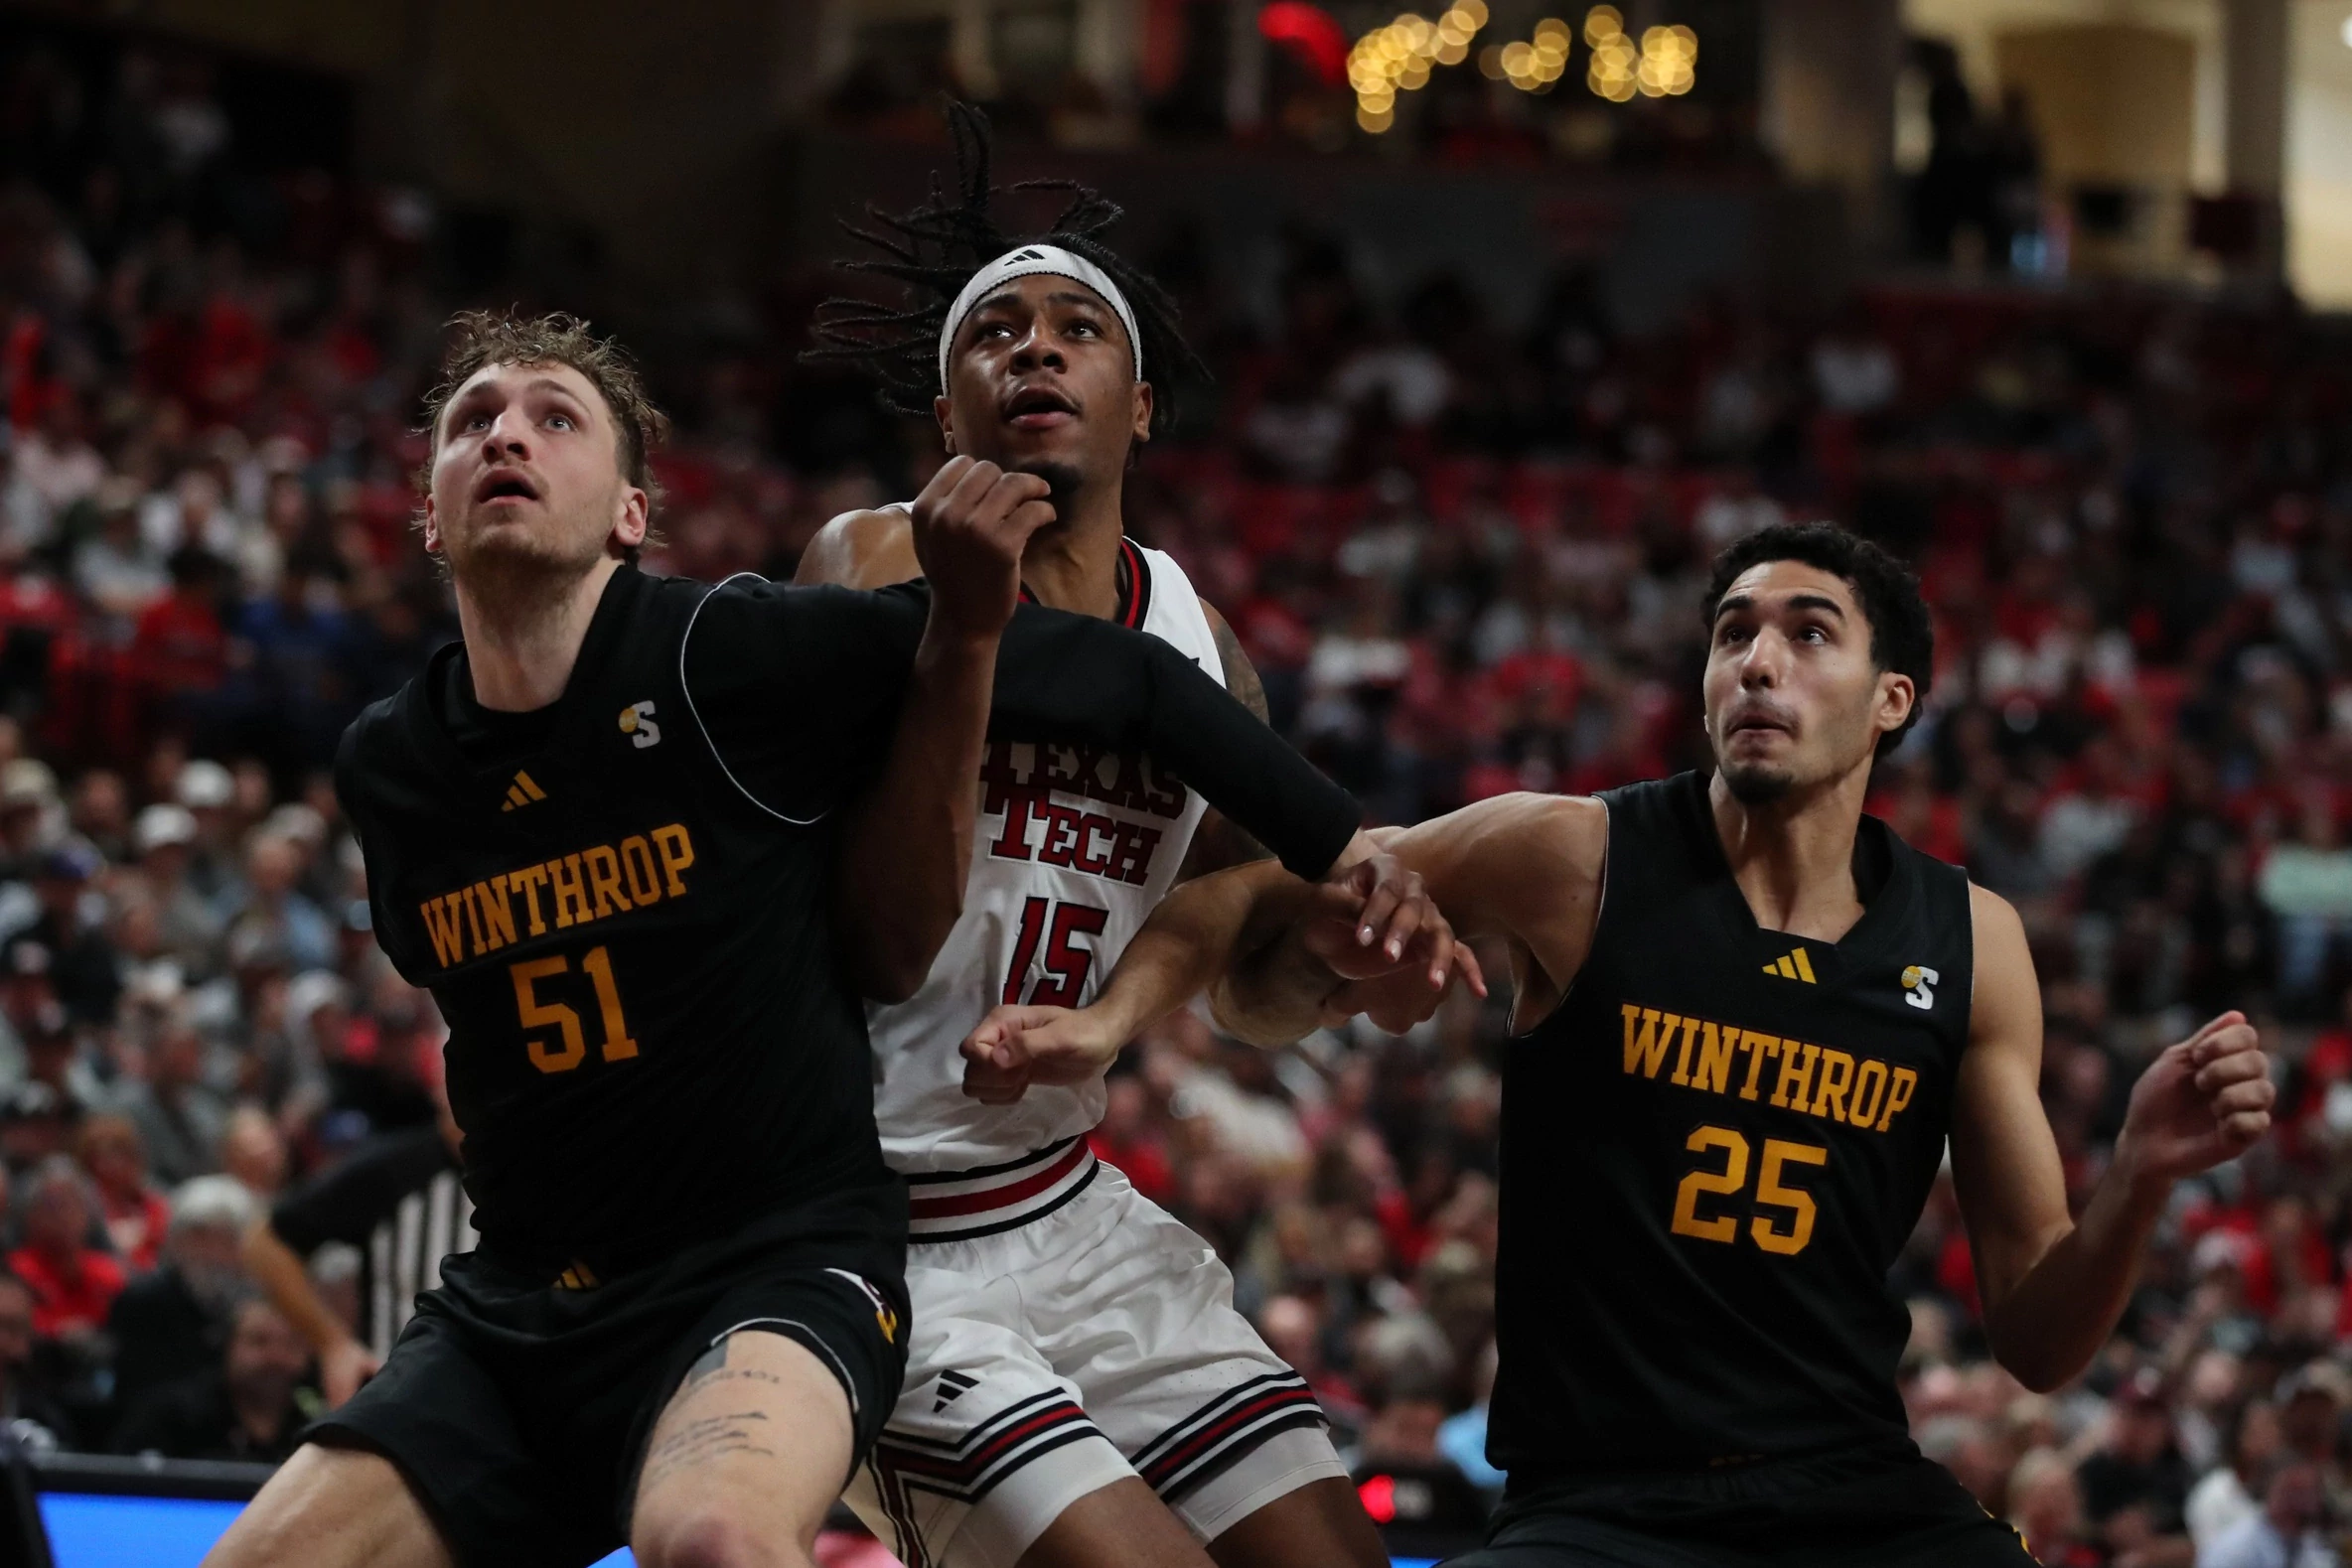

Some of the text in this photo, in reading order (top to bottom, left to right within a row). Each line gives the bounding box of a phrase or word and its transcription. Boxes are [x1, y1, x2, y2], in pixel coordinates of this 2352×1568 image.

[419, 823, 696, 968] WINTHROP
[983, 781, 1162, 887] TECH
[512, 946, 639, 1073] 51
[1001, 896, 1110, 1010] 15
[1620, 1003, 1919, 1133] WINTHROP
[1670, 1124, 1829, 1256] 25
